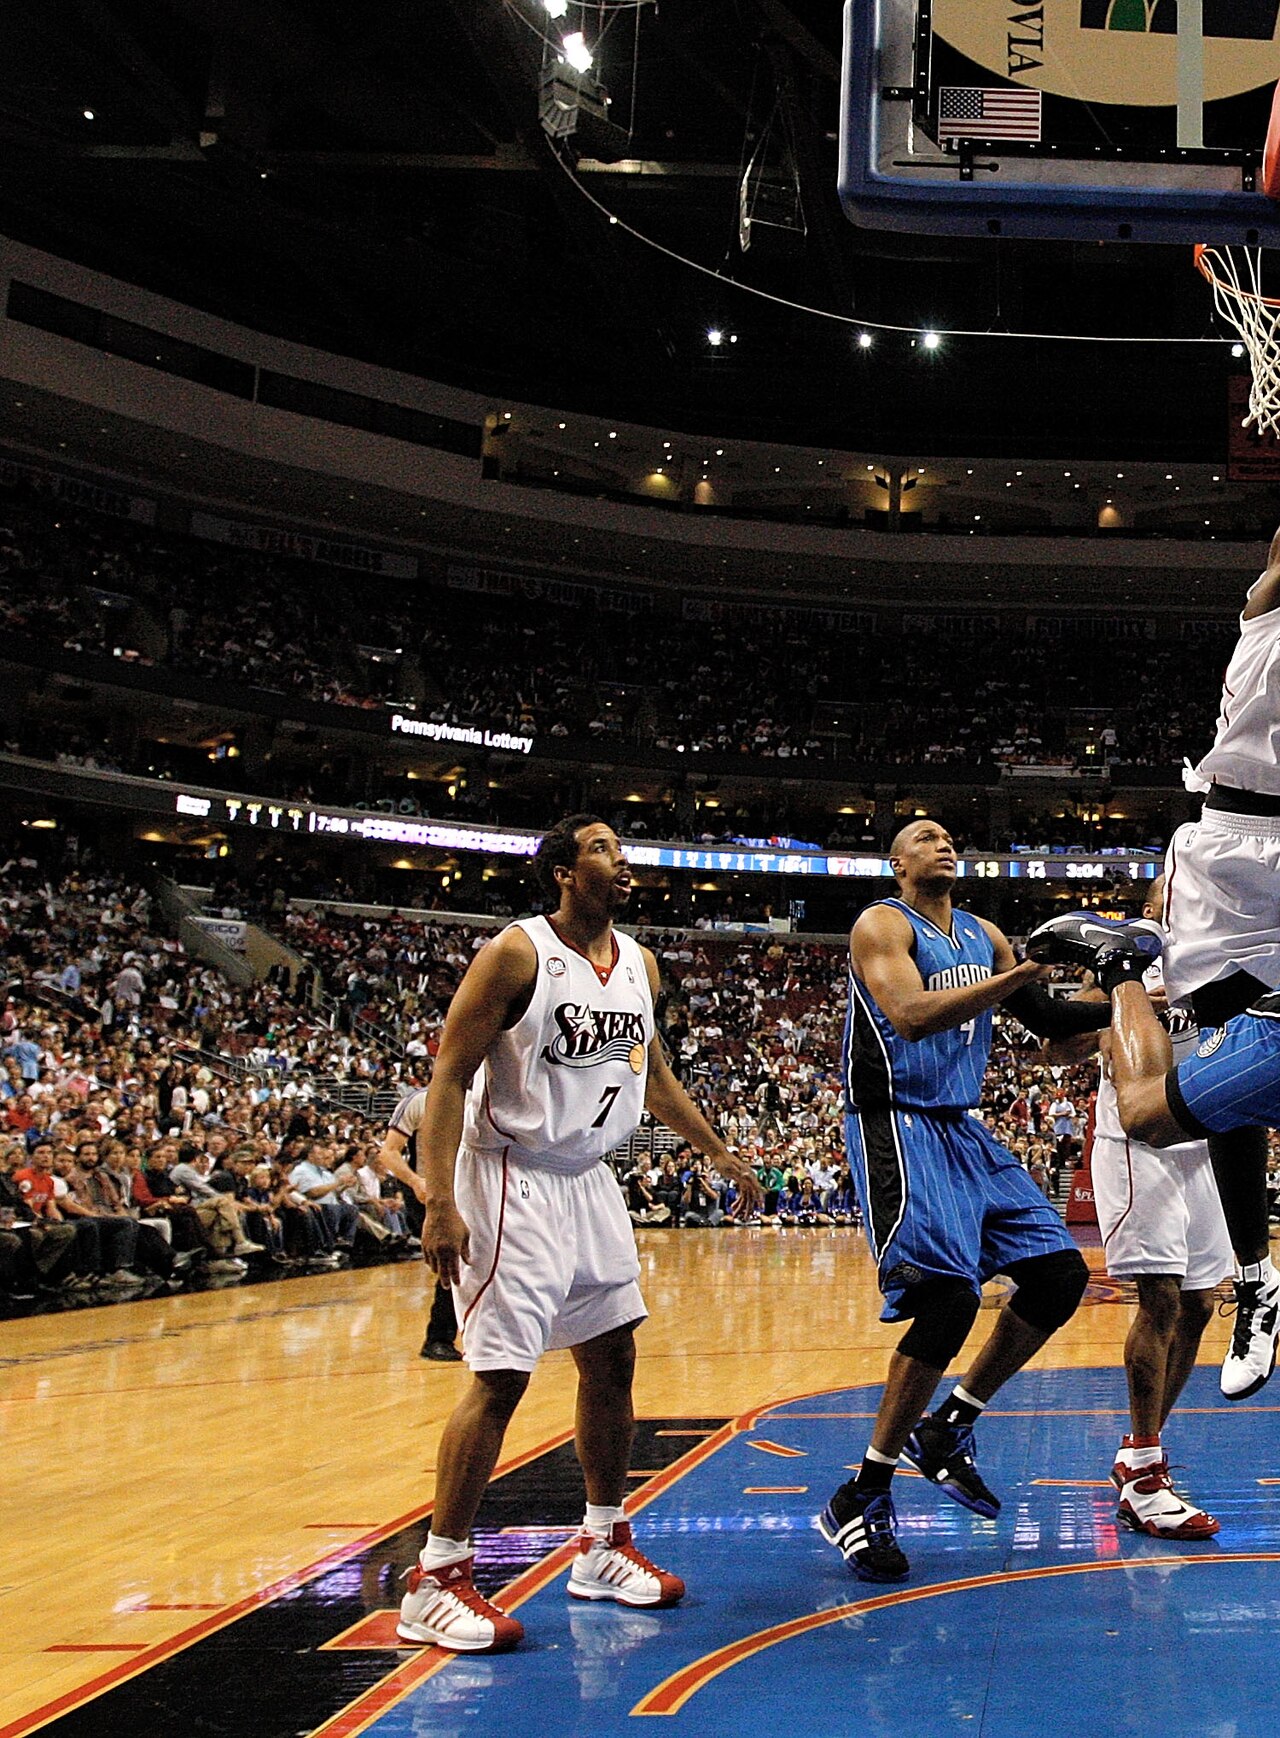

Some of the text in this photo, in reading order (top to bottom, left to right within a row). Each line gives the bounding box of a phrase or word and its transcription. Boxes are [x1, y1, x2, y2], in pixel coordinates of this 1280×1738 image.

[1008, 0, 1044, 77] VIA
[391, 714, 533, 754] Pennsylvania Lottery
[974, 861, 1000, 877] 13
[1066, 863, 1103, 878] 3:04
[590, 1086, 622, 1128] 7
